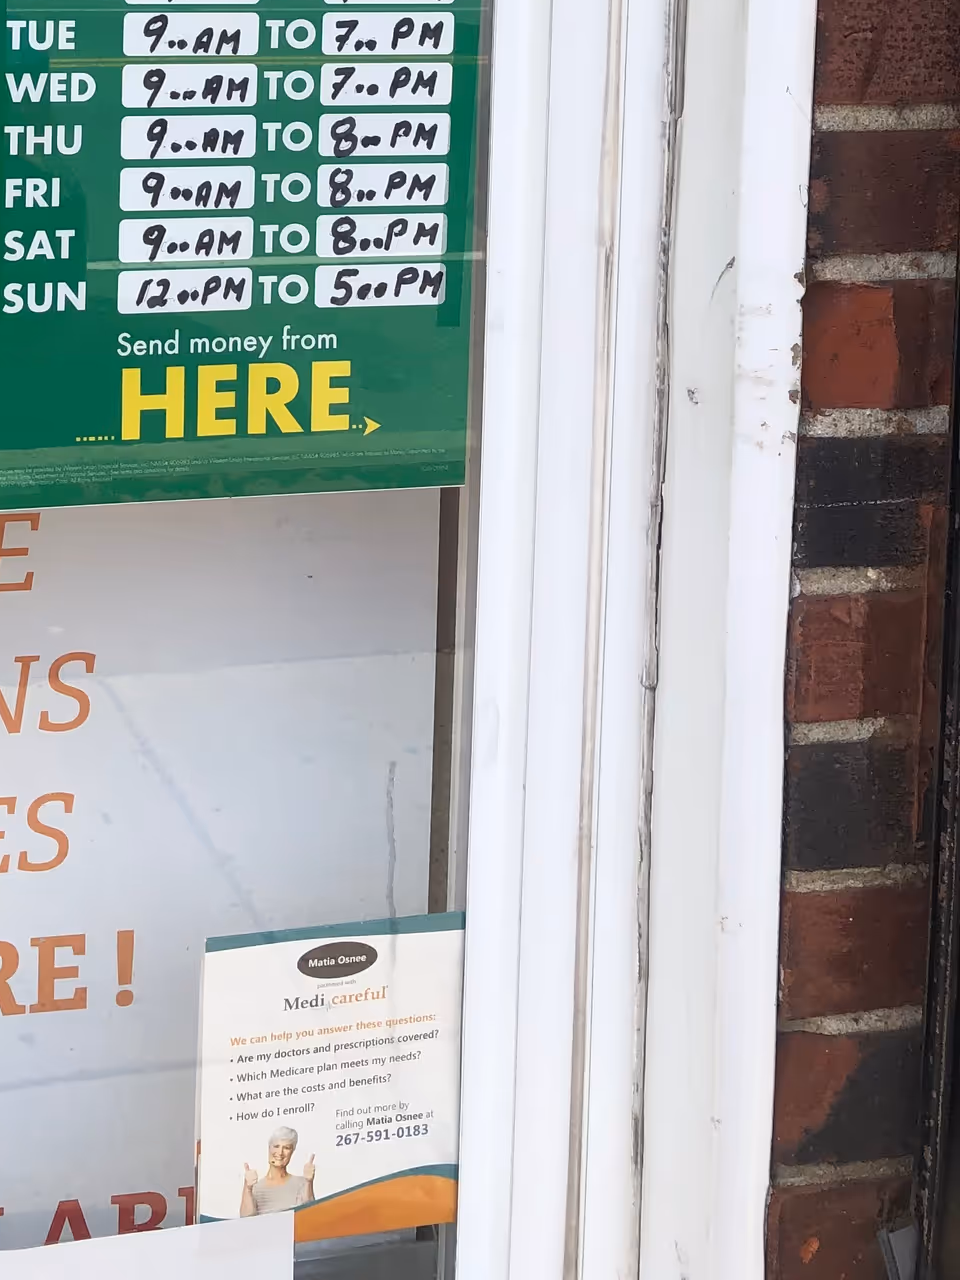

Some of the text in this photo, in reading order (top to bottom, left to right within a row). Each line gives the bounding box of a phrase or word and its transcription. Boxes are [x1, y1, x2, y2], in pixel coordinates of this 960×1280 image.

[5, 20, 76, 51] TUE
[265, 19, 316, 49] TO
[5, 72, 97, 103] WED
[264, 70, 314, 100] TO
[4, 125, 83, 156] THU
[262, 122, 313, 152] TO
[4, 177, 61, 208] FRI
[261, 172, 311, 203] TO
[3, 230, 76, 261] SAT
[260, 224, 310, 253] TO
[2, 281, 87, 313] SUN
[258, 274, 309, 304] TO
[117, 325, 338, 359] Send money from
[121, 360, 352, 441] HERE
[308, 954, 367, 968] Matia Osnee
[230, 1013, 436, 1047] We can help you answer these questions:
[237, 1029, 439, 1064] Are my doctors and prescriptions covered?
[236, 1050, 422, 1083] Which Medicare plan meets my needs?
[236, 1073, 392, 1102] What are the costs and benefits?
[236, 1110, 259, 1122] How
[261, 1107, 274, 1119] do
[283, 1102, 315, 1116] enroll?
[335, 1100, 410, 1118] Find out more by
[335, 1109, 434, 1131] calling Matia Osnee at
[336, 1123, 429, 1147] 267-591-0183
